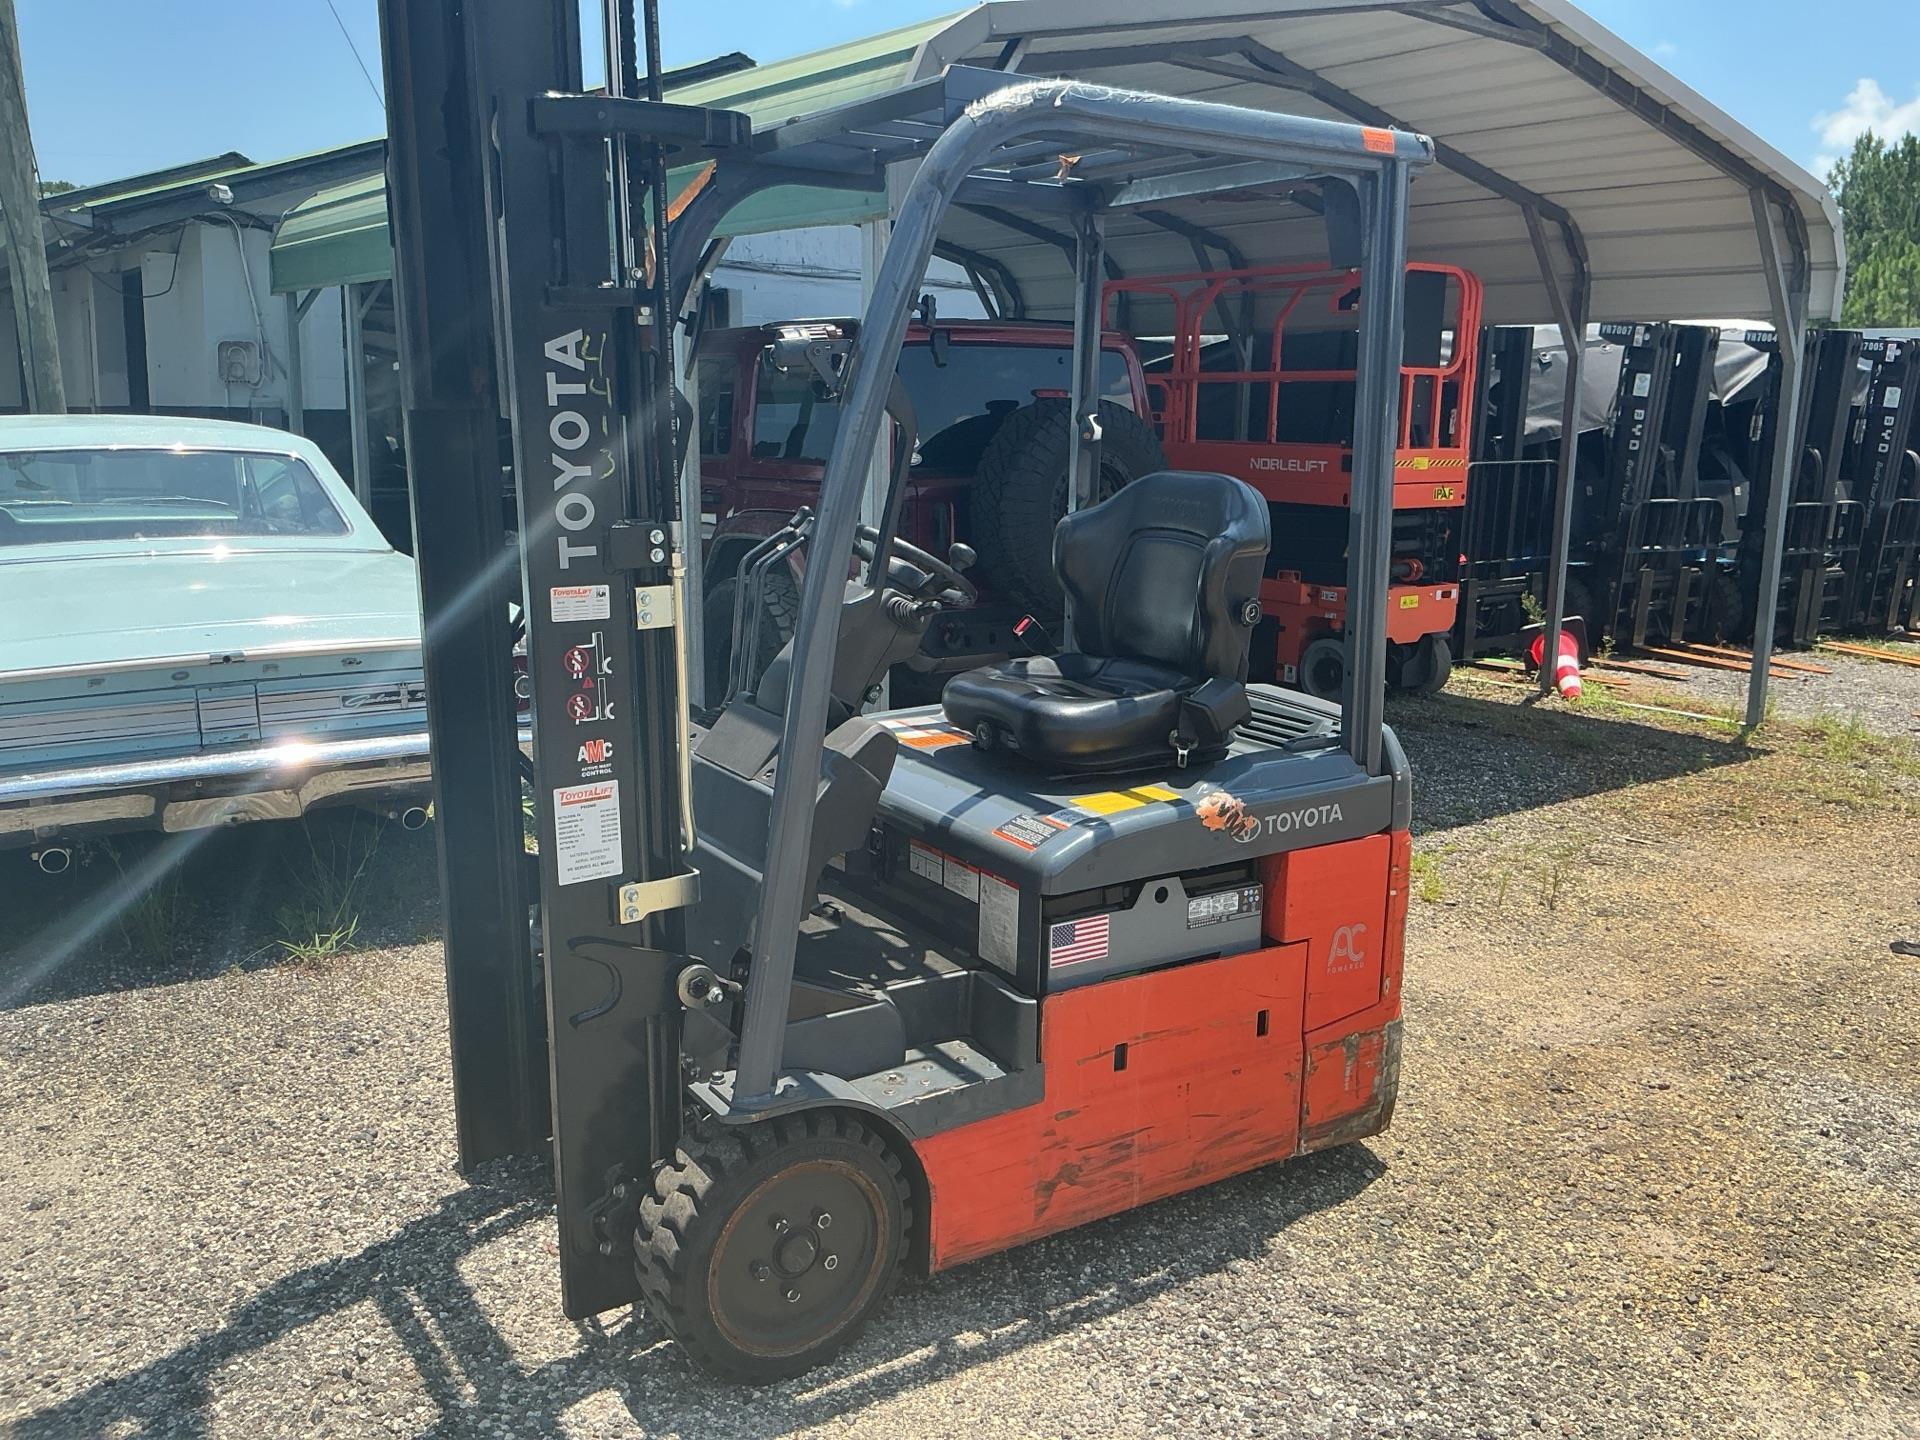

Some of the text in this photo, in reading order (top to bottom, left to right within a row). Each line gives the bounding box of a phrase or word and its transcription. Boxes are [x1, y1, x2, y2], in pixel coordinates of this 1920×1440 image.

[1862, 341, 1885, 351] 7005
[1629, 409, 1645, 450] BYD
[1878, 416, 1895, 453] BYD
[544, 328, 598, 570] TOYOTA
[1433, 484, 1454, 500] IPAF
[577, 739, 613, 764] AMC
[581, 768, 613, 778] CONTROL
[1265, 803, 1343, 835] TOYOTA
[1327, 923, 1368, 966] AC
